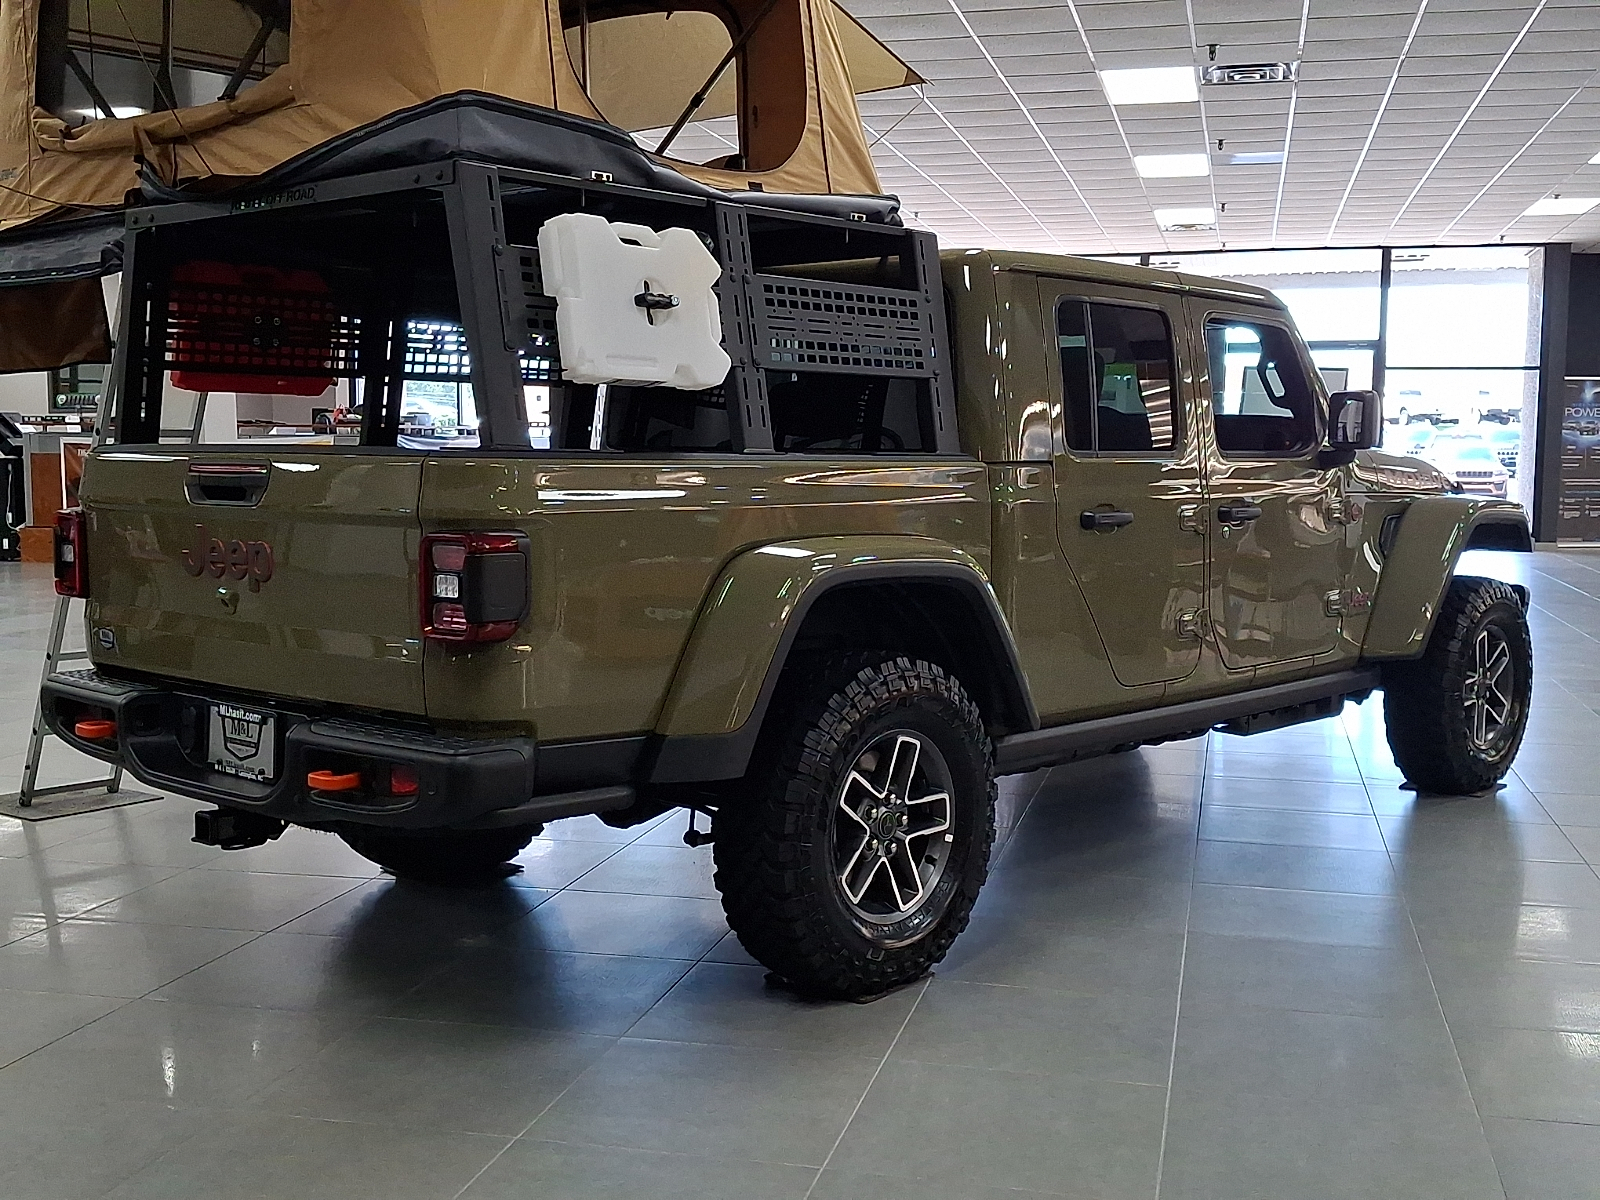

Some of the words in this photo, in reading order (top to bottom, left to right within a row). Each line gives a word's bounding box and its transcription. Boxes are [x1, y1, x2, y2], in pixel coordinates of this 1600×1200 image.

[1564, 407, 1600, 418] POWE
[181, 522, 275, 594] Jeep
[219, 704, 262, 722] MLhasit.com
[230, 719, 254, 739] M&L
